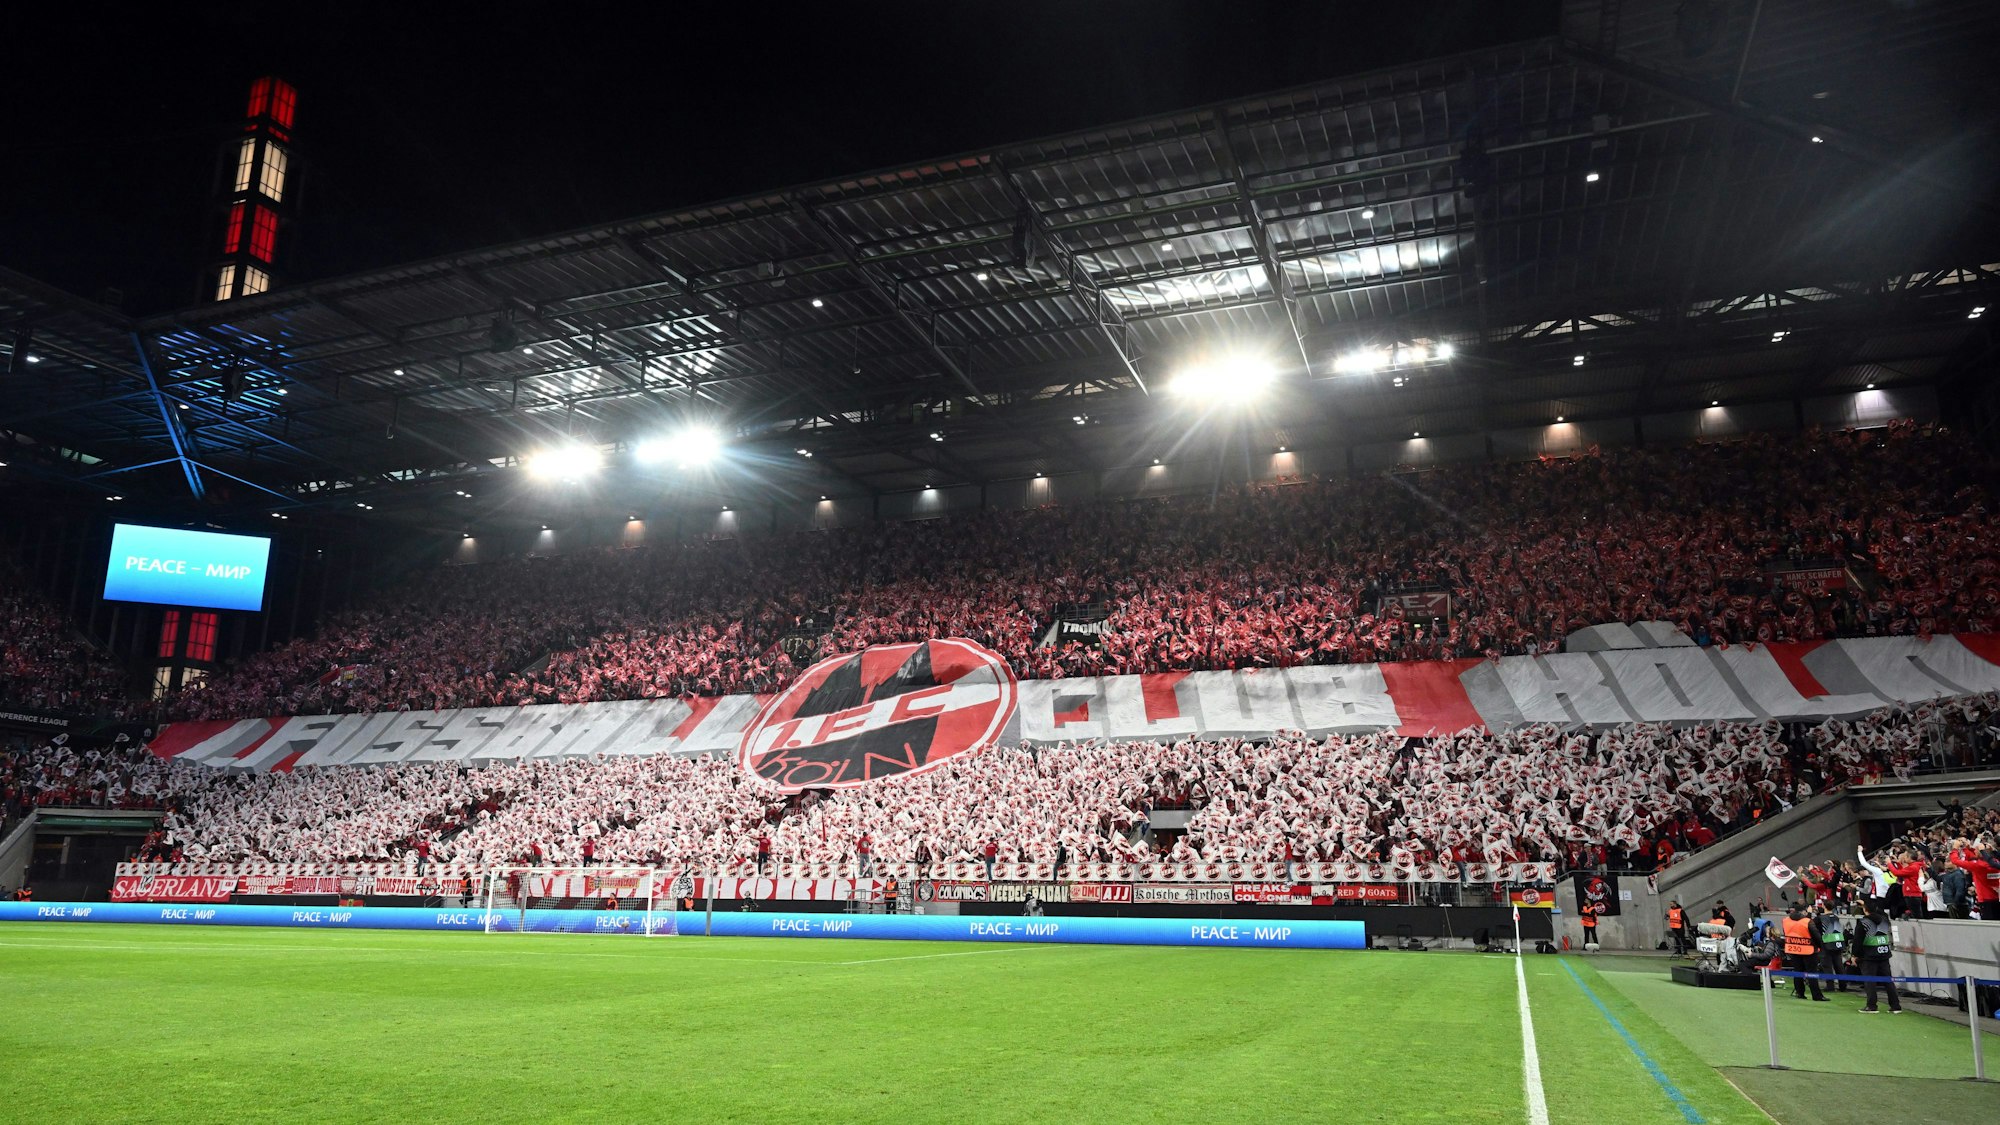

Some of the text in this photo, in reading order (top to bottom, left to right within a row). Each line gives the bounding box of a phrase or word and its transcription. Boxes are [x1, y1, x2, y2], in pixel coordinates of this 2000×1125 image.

[125, 555, 187, 575] PEACE
[205, 563, 251, 580] МИР
[1786, 573, 1806, 581] HANS
[228, 694, 746, 768] FUSSBALL
[1018, 661, 1402, 741] CLUB
[1487, 620, 2000, 724] KÖLN
[40, 716, 69, 727] LEAGUE
[755, 742, 919, 787] KÖLN
[376, 877, 418, 895] DOMSTADT
[440, 877, 481, 896] SYNDAT
[938, 884, 987, 900] COLONIACS
[1234, 884, 1290, 893] FREAKS
[1337, 887, 1354, 896] RED
[1367, 886, 1397, 897] GOATS
[1102, 886, 1130, 901] AJJ
[38, 906, 66, 917] PEACE
[72, 907, 92, 917] МИР
[161, 908, 188, 919] PEACE
[194, 909, 216, 920] МИР
[292, 911, 321, 922] PEACE
[329, 912, 352, 923] МИР
[437, 913, 468, 925] PEACE
[596, 915, 630, 927] PEACE
[773, 919, 810, 932] PEACE
[822, 920, 853, 932] МИР
[970, 922, 1012, 935] PEACE
[1025, 923, 1059, 936] МИР
[1191, 926, 1239, 939] PEACE
[1254, 927, 1292, 941] МИР
[1787, 945, 1802, 953] 230
